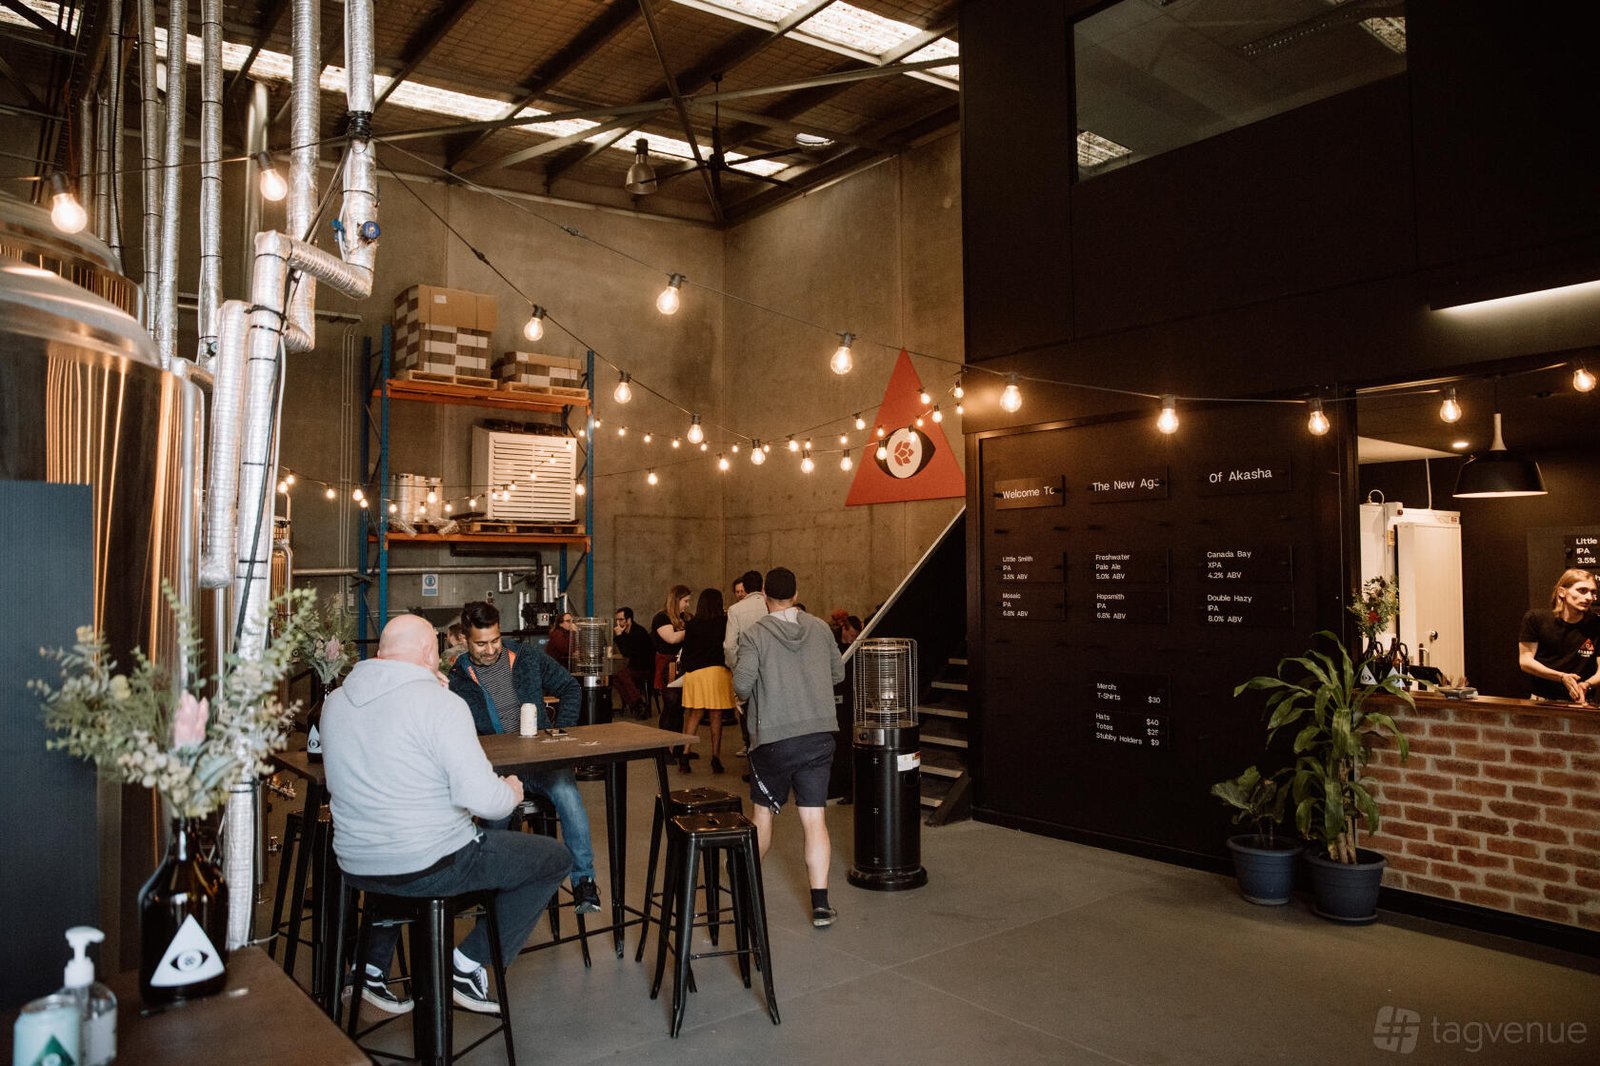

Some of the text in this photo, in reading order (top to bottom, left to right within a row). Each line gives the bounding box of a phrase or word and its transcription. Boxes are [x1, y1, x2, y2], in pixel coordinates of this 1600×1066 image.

[1209, 468, 1272, 483] Of Akasha
[1092, 482, 1110, 491] The
[1114, 480, 1135, 490] New
[1003, 489, 1040, 499] Welcome
[1237, 550, 1252, 558] Bay
[1096, 593, 1125, 601] Hopsmith
[1207, 594, 1252, 604] Double Hazy
[1096, 713, 1159, 726] Hats $40
[1096, 722, 1113, 731] Totes
[1096, 732, 1160, 746] Stubby Holders $9
